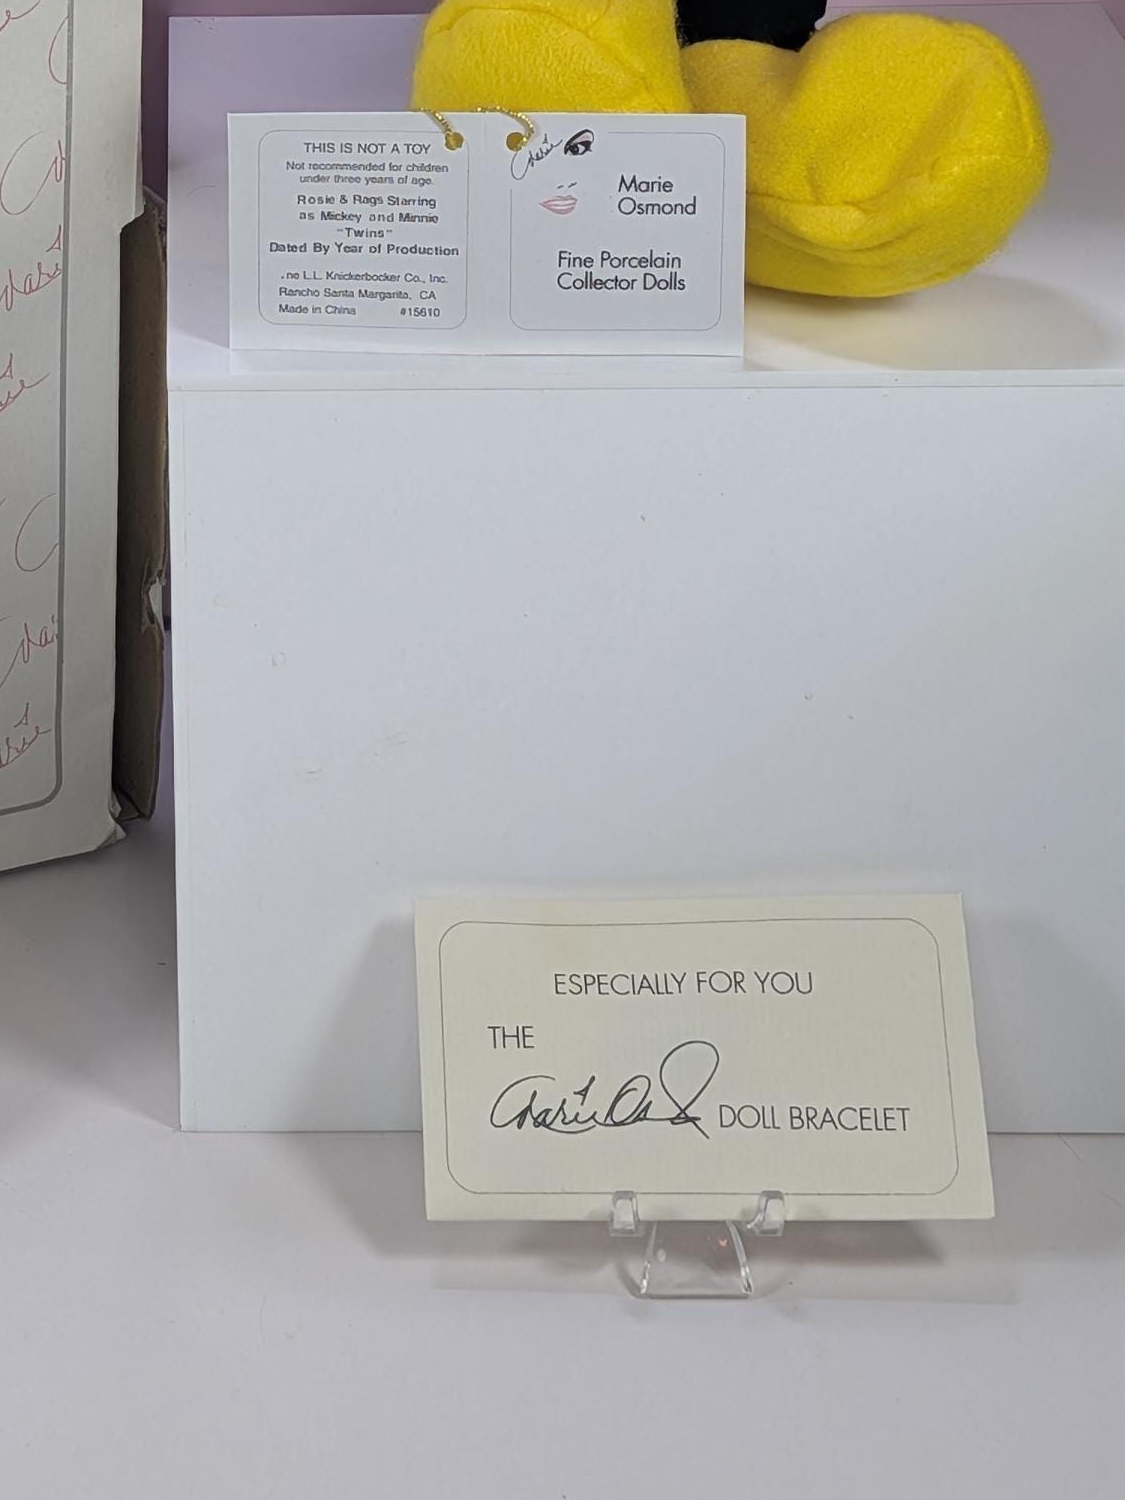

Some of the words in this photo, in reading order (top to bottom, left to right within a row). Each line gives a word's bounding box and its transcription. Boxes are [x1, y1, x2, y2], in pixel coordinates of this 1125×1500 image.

[304, 142, 335, 153] THIS
[340, 143, 353, 153] IS
[357, 143, 386, 154] NOT
[391, 143, 400, 154] A
[404, 143, 431, 154] TOY
[286, 161, 305, 171] Not
[309, 162, 385, 172] recommended
[388, 163, 402, 172] for
[406, 163, 449, 172] children
[299, 175, 330, 183] under
[334, 175, 361, 184] three
[364, 176, 394, 185] years
[398, 175, 408, 184] of
[411, 177, 434, 187] age.
[618, 175, 674, 193] Marie
[297, 195, 335, 205] Rosie
[340, 195, 348, 205] &
[353, 195, 383, 207] Rags
[387, 196, 437, 208] Starring
[617, 196, 696, 215] Osmond
[299, 212, 314, 220] as
[321, 211, 362, 223] Mickey
[369, 213, 394, 222] and
[399, 213, 439, 223] Minnie
[337, 227, 393, 238] "Twins"
[269, 242, 307, 253] Dated
[313, 243, 330, 255] By
[335, 242, 363, 254] Year
[369, 243, 382, 254] of
[387, 244, 459, 256] Production
[558, 251, 594, 268] Fine
[601, 249, 681, 269] Porcelain
[326, 271, 400, 282] Knickerbocker
[430, 274, 449, 283] Inc.
[557, 271, 638, 290] Collector
[643, 272, 686, 291] Dolls
[279, 287, 320, 297] Rancho
[324, 288, 354, 298] Santa
[419, 291, 437, 300] CA
[278, 304, 308, 314] Made
[312, 305, 322, 314] in
[325, 305, 356, 315] China
[554, 972, 686, 996] ESPECIALLY
[696, 971, 746, 994] FOR
[754, 972, 813, 994] YOU
[488, 1025, 535, 1049] THE
[719, 1104, 780, 1130] DOLL
[789, 1107, 910, 1132] BRACELET
